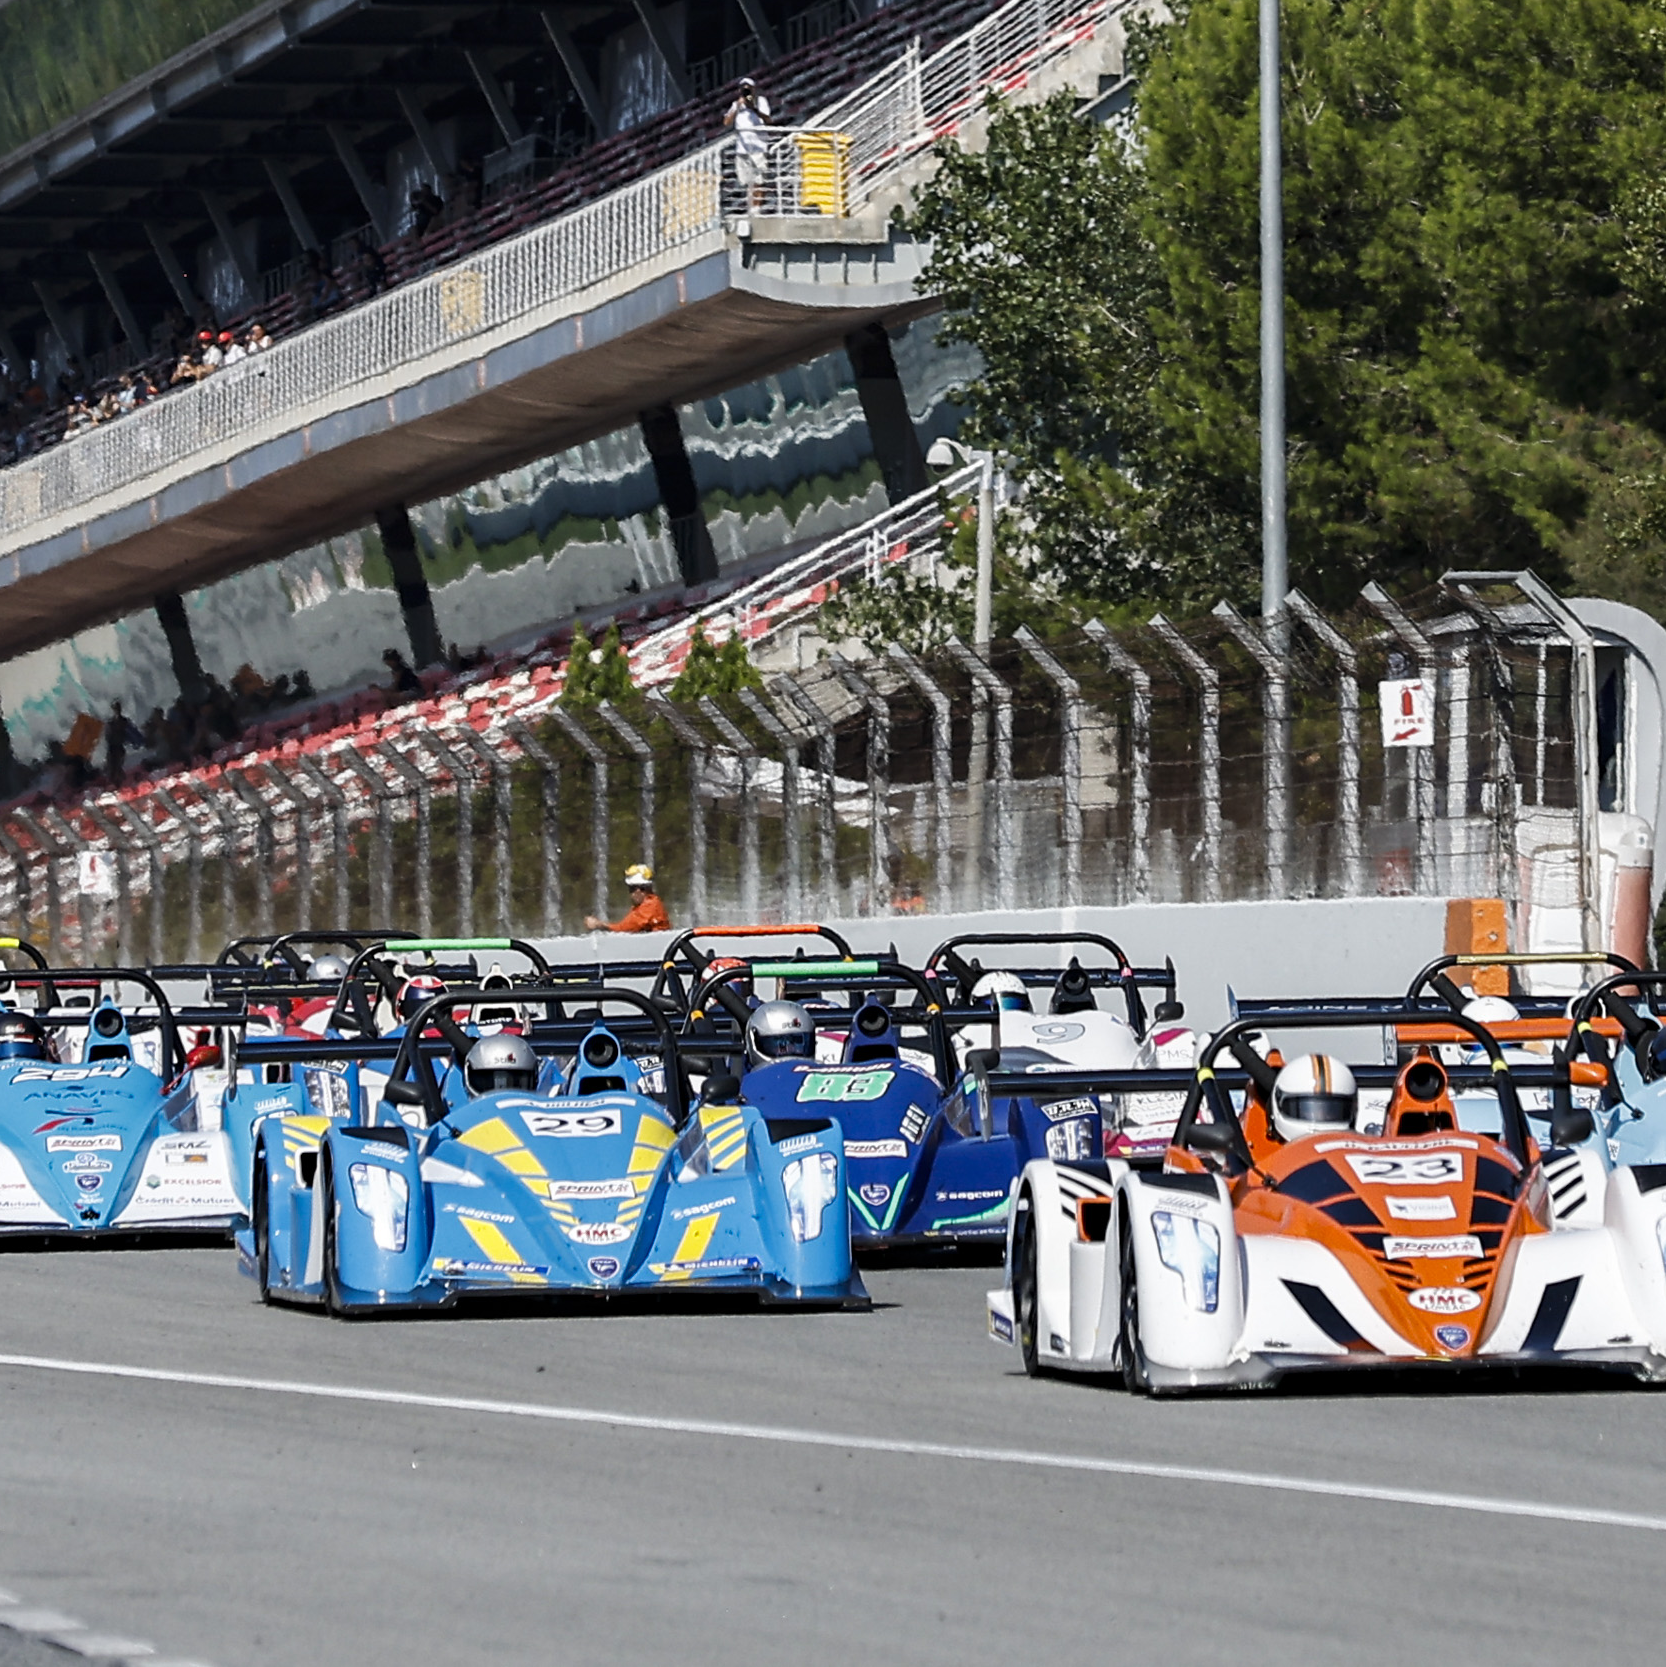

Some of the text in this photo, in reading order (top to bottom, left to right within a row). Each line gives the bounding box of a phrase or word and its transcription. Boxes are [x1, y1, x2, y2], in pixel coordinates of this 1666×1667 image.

[1032, 1022, 1085, 1044] 9
[10, 1066, 130, 1086] 294
[796, 1070, 896, 1103] 83
[534, 1115, 615, 1133] 29
[1361, 1158, 1458, 1179] 23
[949, 1189, 1003, 1200] sagcom
[456, 1206, 515, 1224] sagcom
[682, 1196, 736, 1217] sagcom
[576, 1228, 623, 1239] HMC
[466, 1262, 536, 1274] MICHELIN
[684, 1257, 749, 1270] MICHELIN
[1419, 1294, 1472, 1305] HMC
